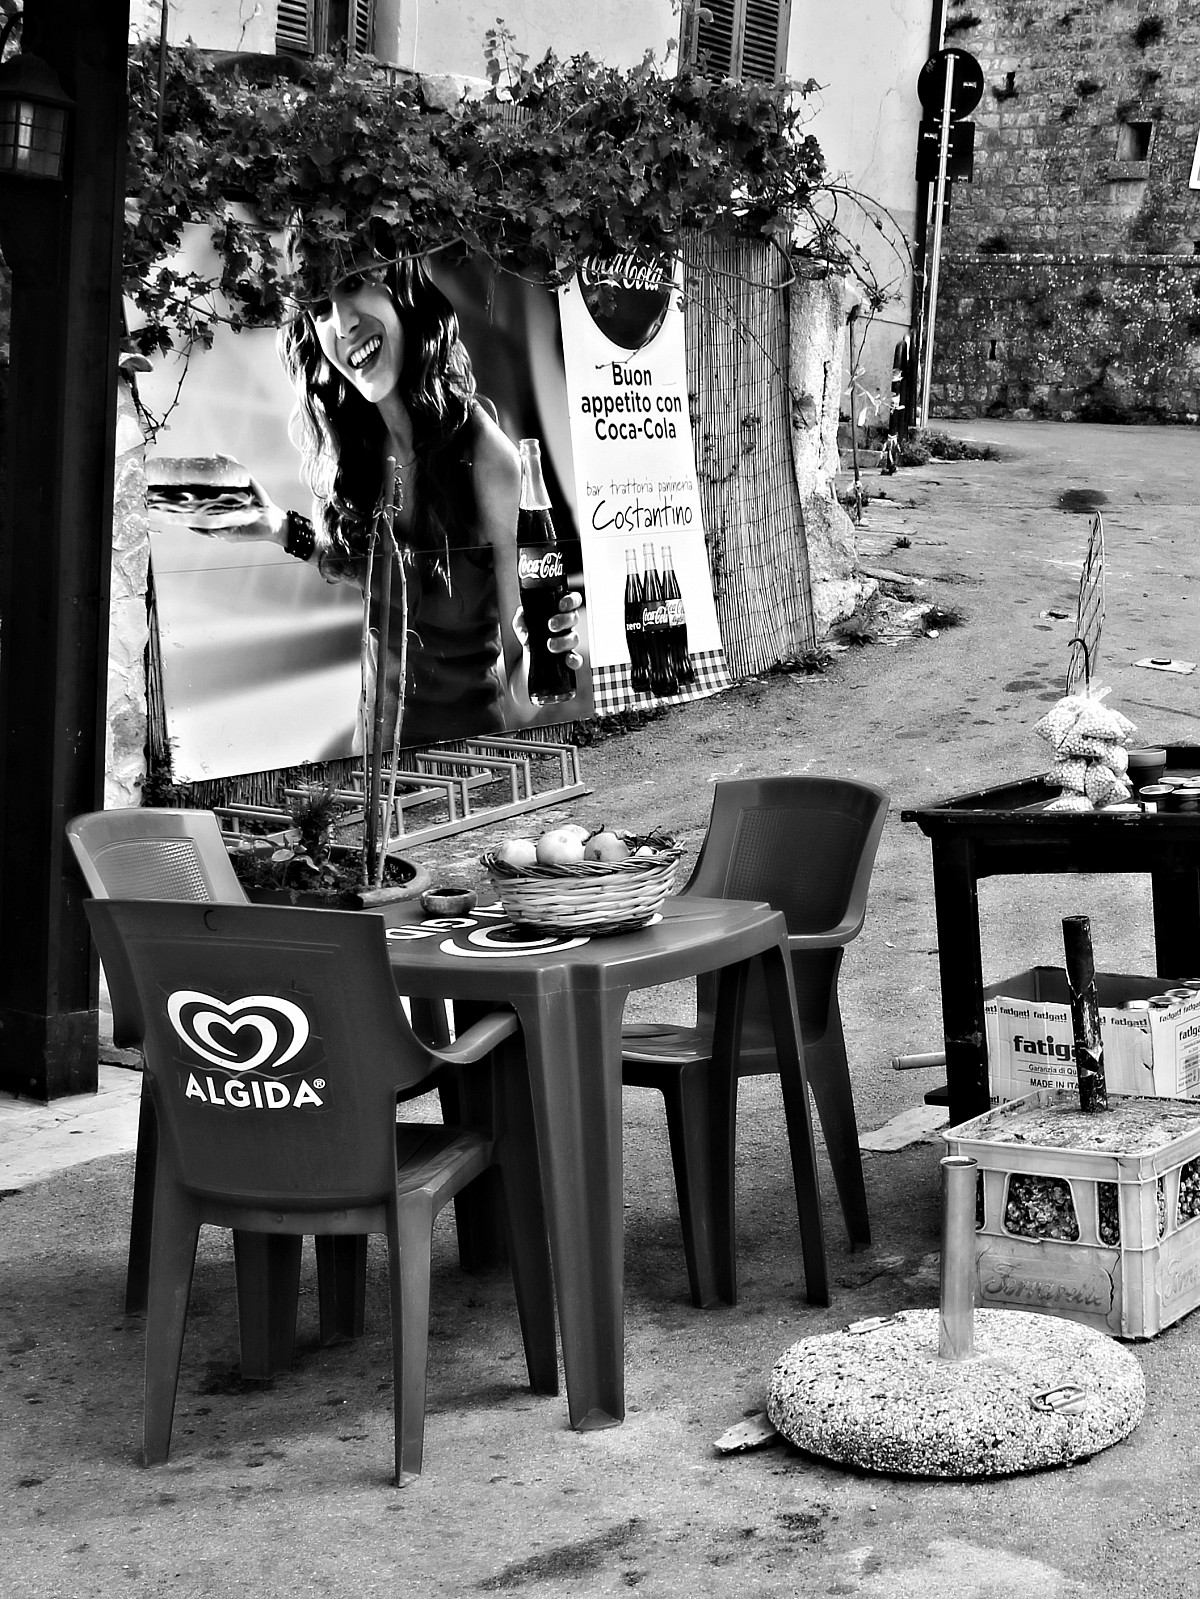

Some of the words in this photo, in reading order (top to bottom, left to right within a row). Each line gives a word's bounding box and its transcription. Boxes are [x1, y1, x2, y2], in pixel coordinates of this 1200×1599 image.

[611, 363, 653, 387] Buon
[580, 390, 653, 418] appetito
[655, 395, 683, 413] con
[594, 417, 678, 441] Coca-Cola
[585, 480, 604, 497] bar
[609, 476, 654, 496] trattoria
[657, 474, 693, 501] panineria
[591, 496, 693, 532] Costantino
[518, 551, 564, 580] Coca-Cola
[626, 622, 642, 631] zero
[1028, 1063, 1058, 1075] Garanzia
[1058, 1066, 1066, 1075] di
[1030, 1078, 1054, 1089] MADE
[1055, 1080, 1065, 1090] IN
